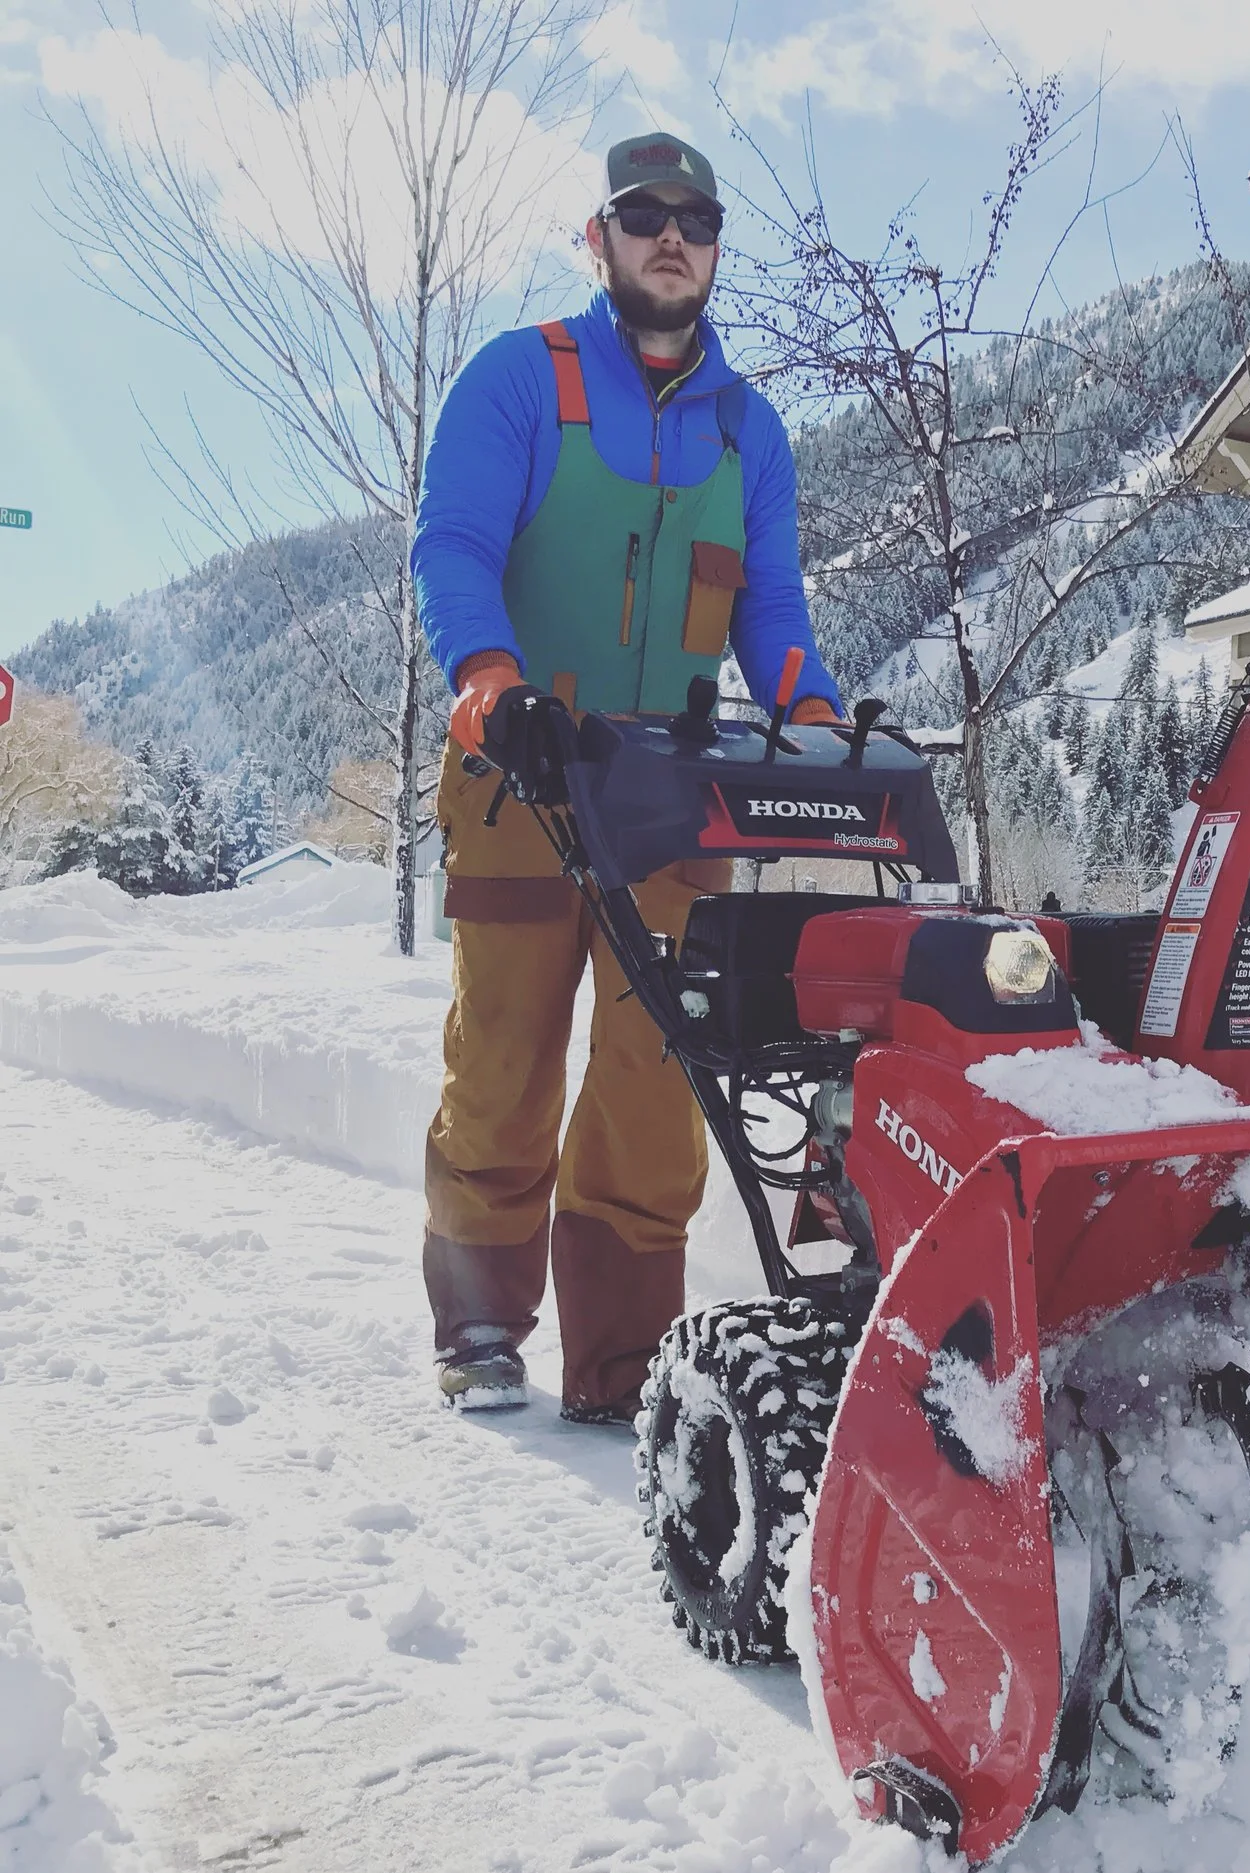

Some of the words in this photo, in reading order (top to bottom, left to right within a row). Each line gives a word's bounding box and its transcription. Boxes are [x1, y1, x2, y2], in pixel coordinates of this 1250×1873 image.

[0, 508, 26, 526] Run
[747, 799, 866, 822] HONDA
[834, 833, 898, 849] Hydrostatic
[1235, 970, 1248, 978] LED
[1229, 992, 1248, 1002] height
